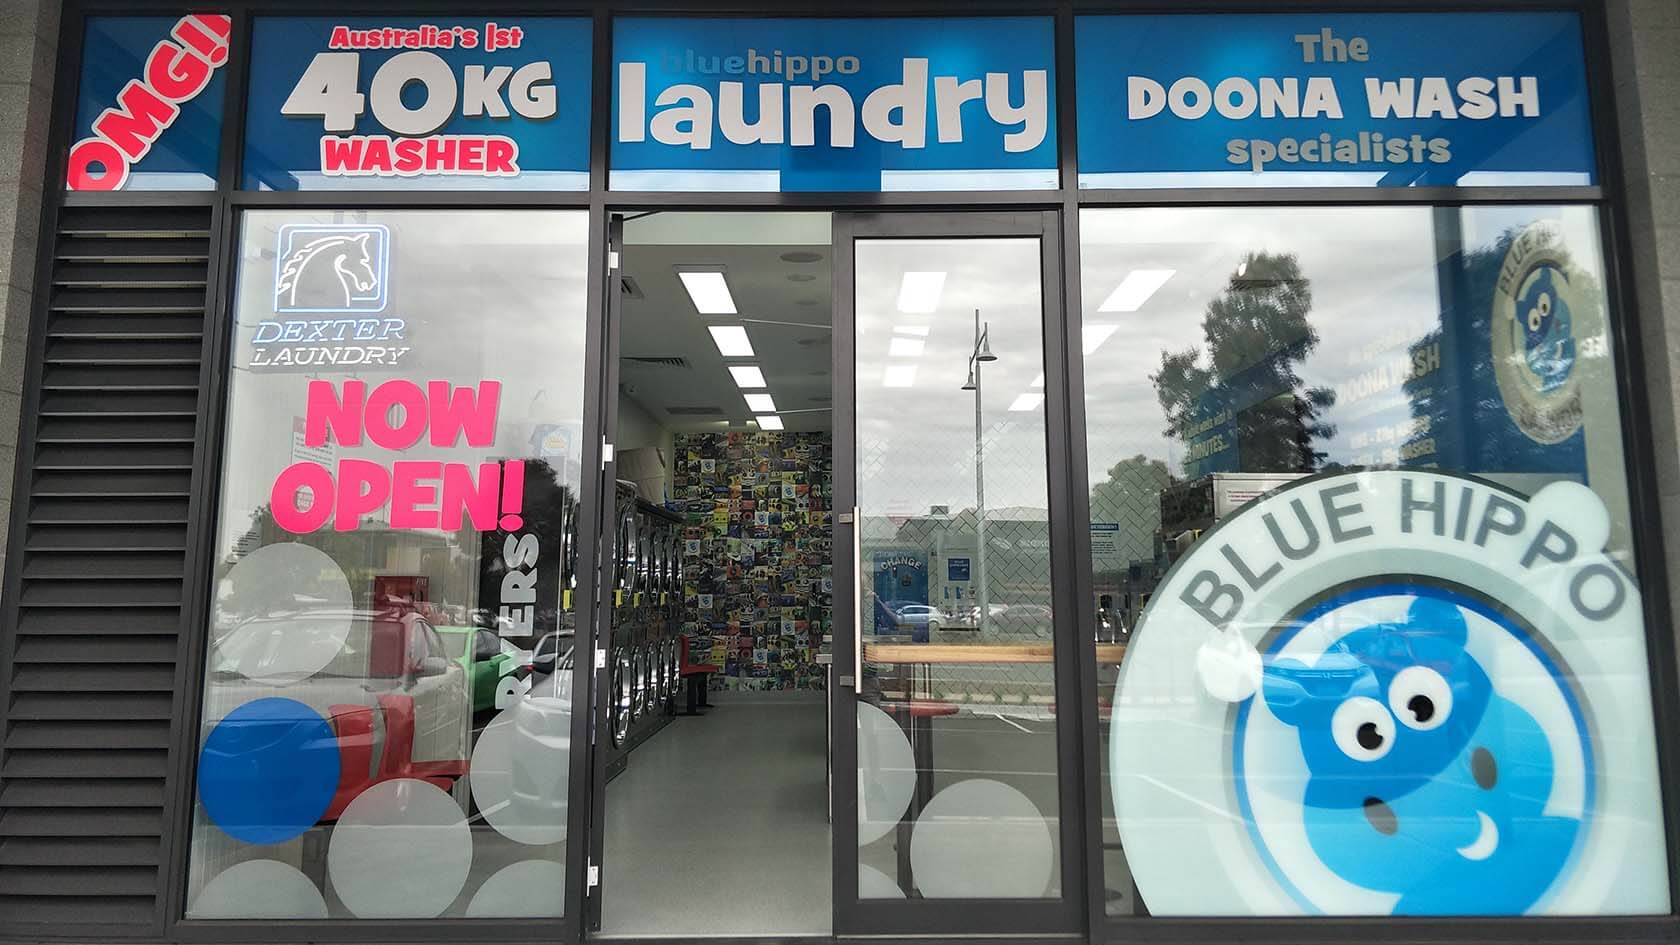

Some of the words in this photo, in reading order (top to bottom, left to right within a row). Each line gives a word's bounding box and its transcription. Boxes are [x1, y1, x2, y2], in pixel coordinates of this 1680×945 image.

[328, 24, 479, 50] Australia's
[1294, 27, 1370, 64] The
[618, 57, 1048, 154] laundry
[1127, 76, 1344, 121] DOONA
[1365, 76, 1540, 119] WASH
[320, 134, 521, 178] WASHER
[1226, 132, 1452, 174] specialists
[252, 318, 407, 345] DEXTER
[249, 347, 411, 367] LAUNDRY
[304, 380, 501, 451] NOW
[270, 458, 525, 534] OPEN!
[880, 556, 923, 571] CHANGE
[1179, 482, 1374, 633] BLUE
[1401, 478, 1627, 622] HIPPO
